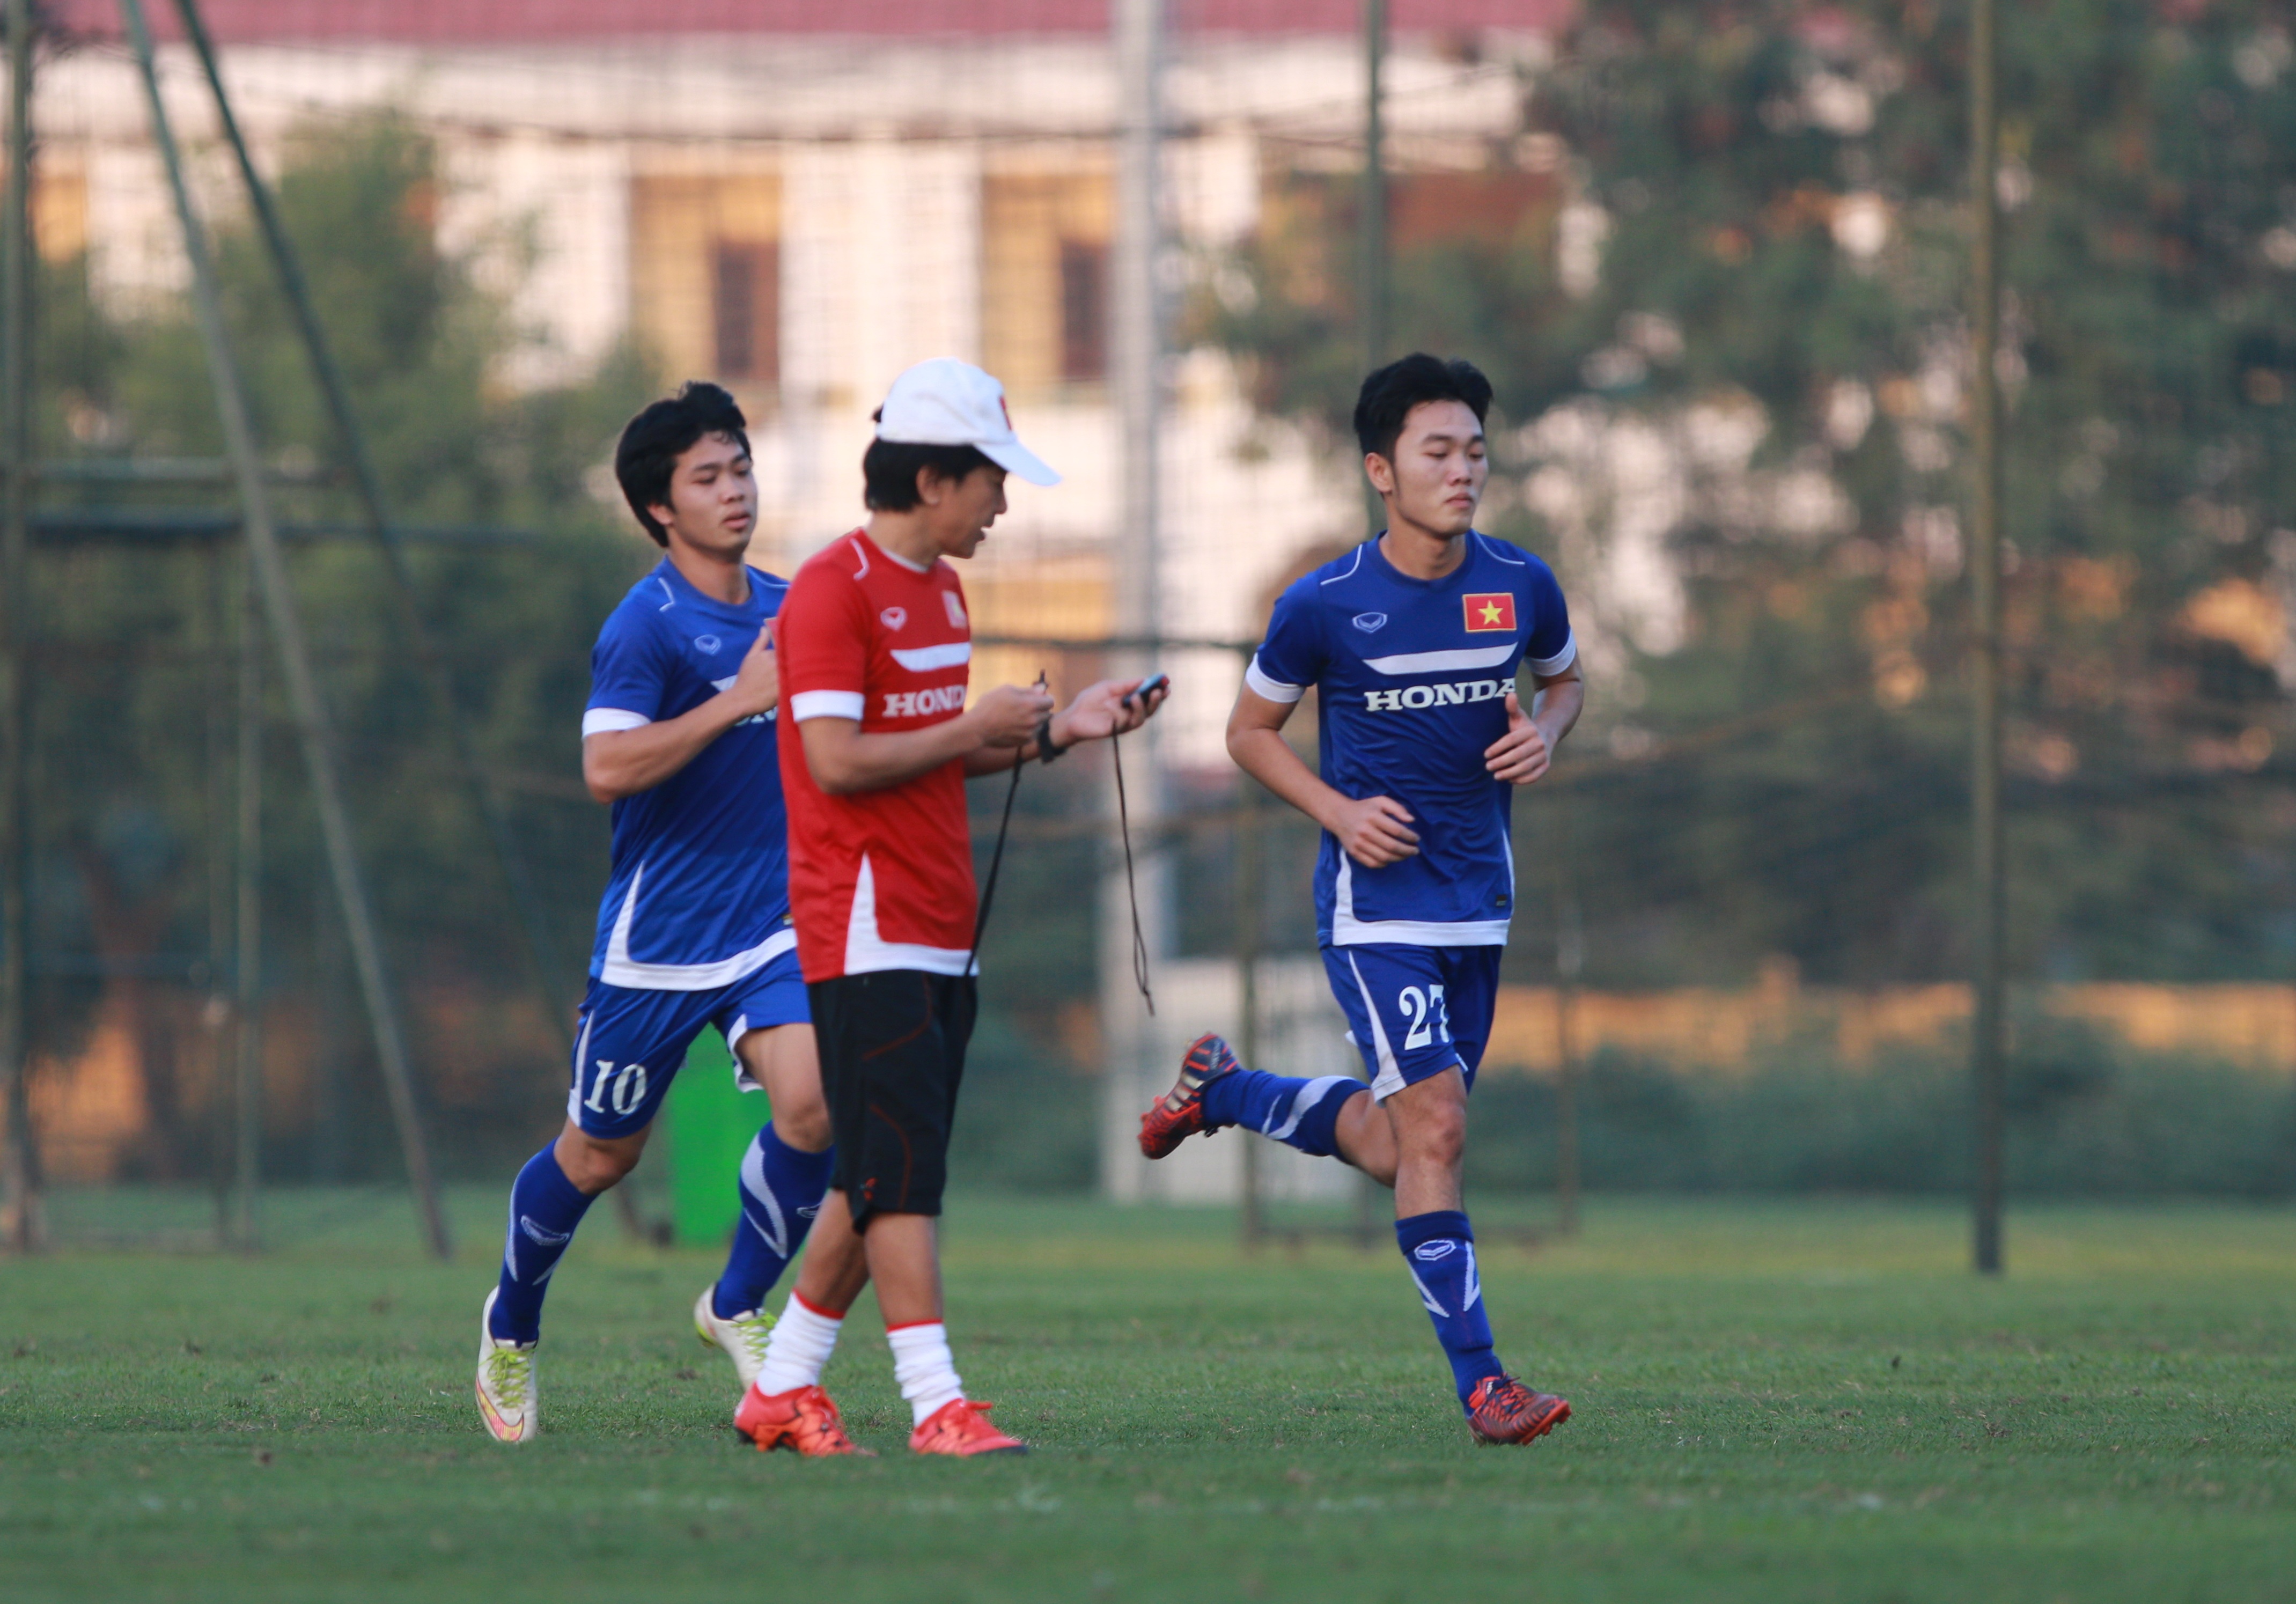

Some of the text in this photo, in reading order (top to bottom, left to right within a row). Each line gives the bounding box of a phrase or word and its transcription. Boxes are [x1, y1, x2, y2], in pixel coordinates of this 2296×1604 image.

[1364, 678, 1515, 712] HONDA
[1399, 984, 1449, 1050] 27
[584, 1059, 646, 1115] 10
